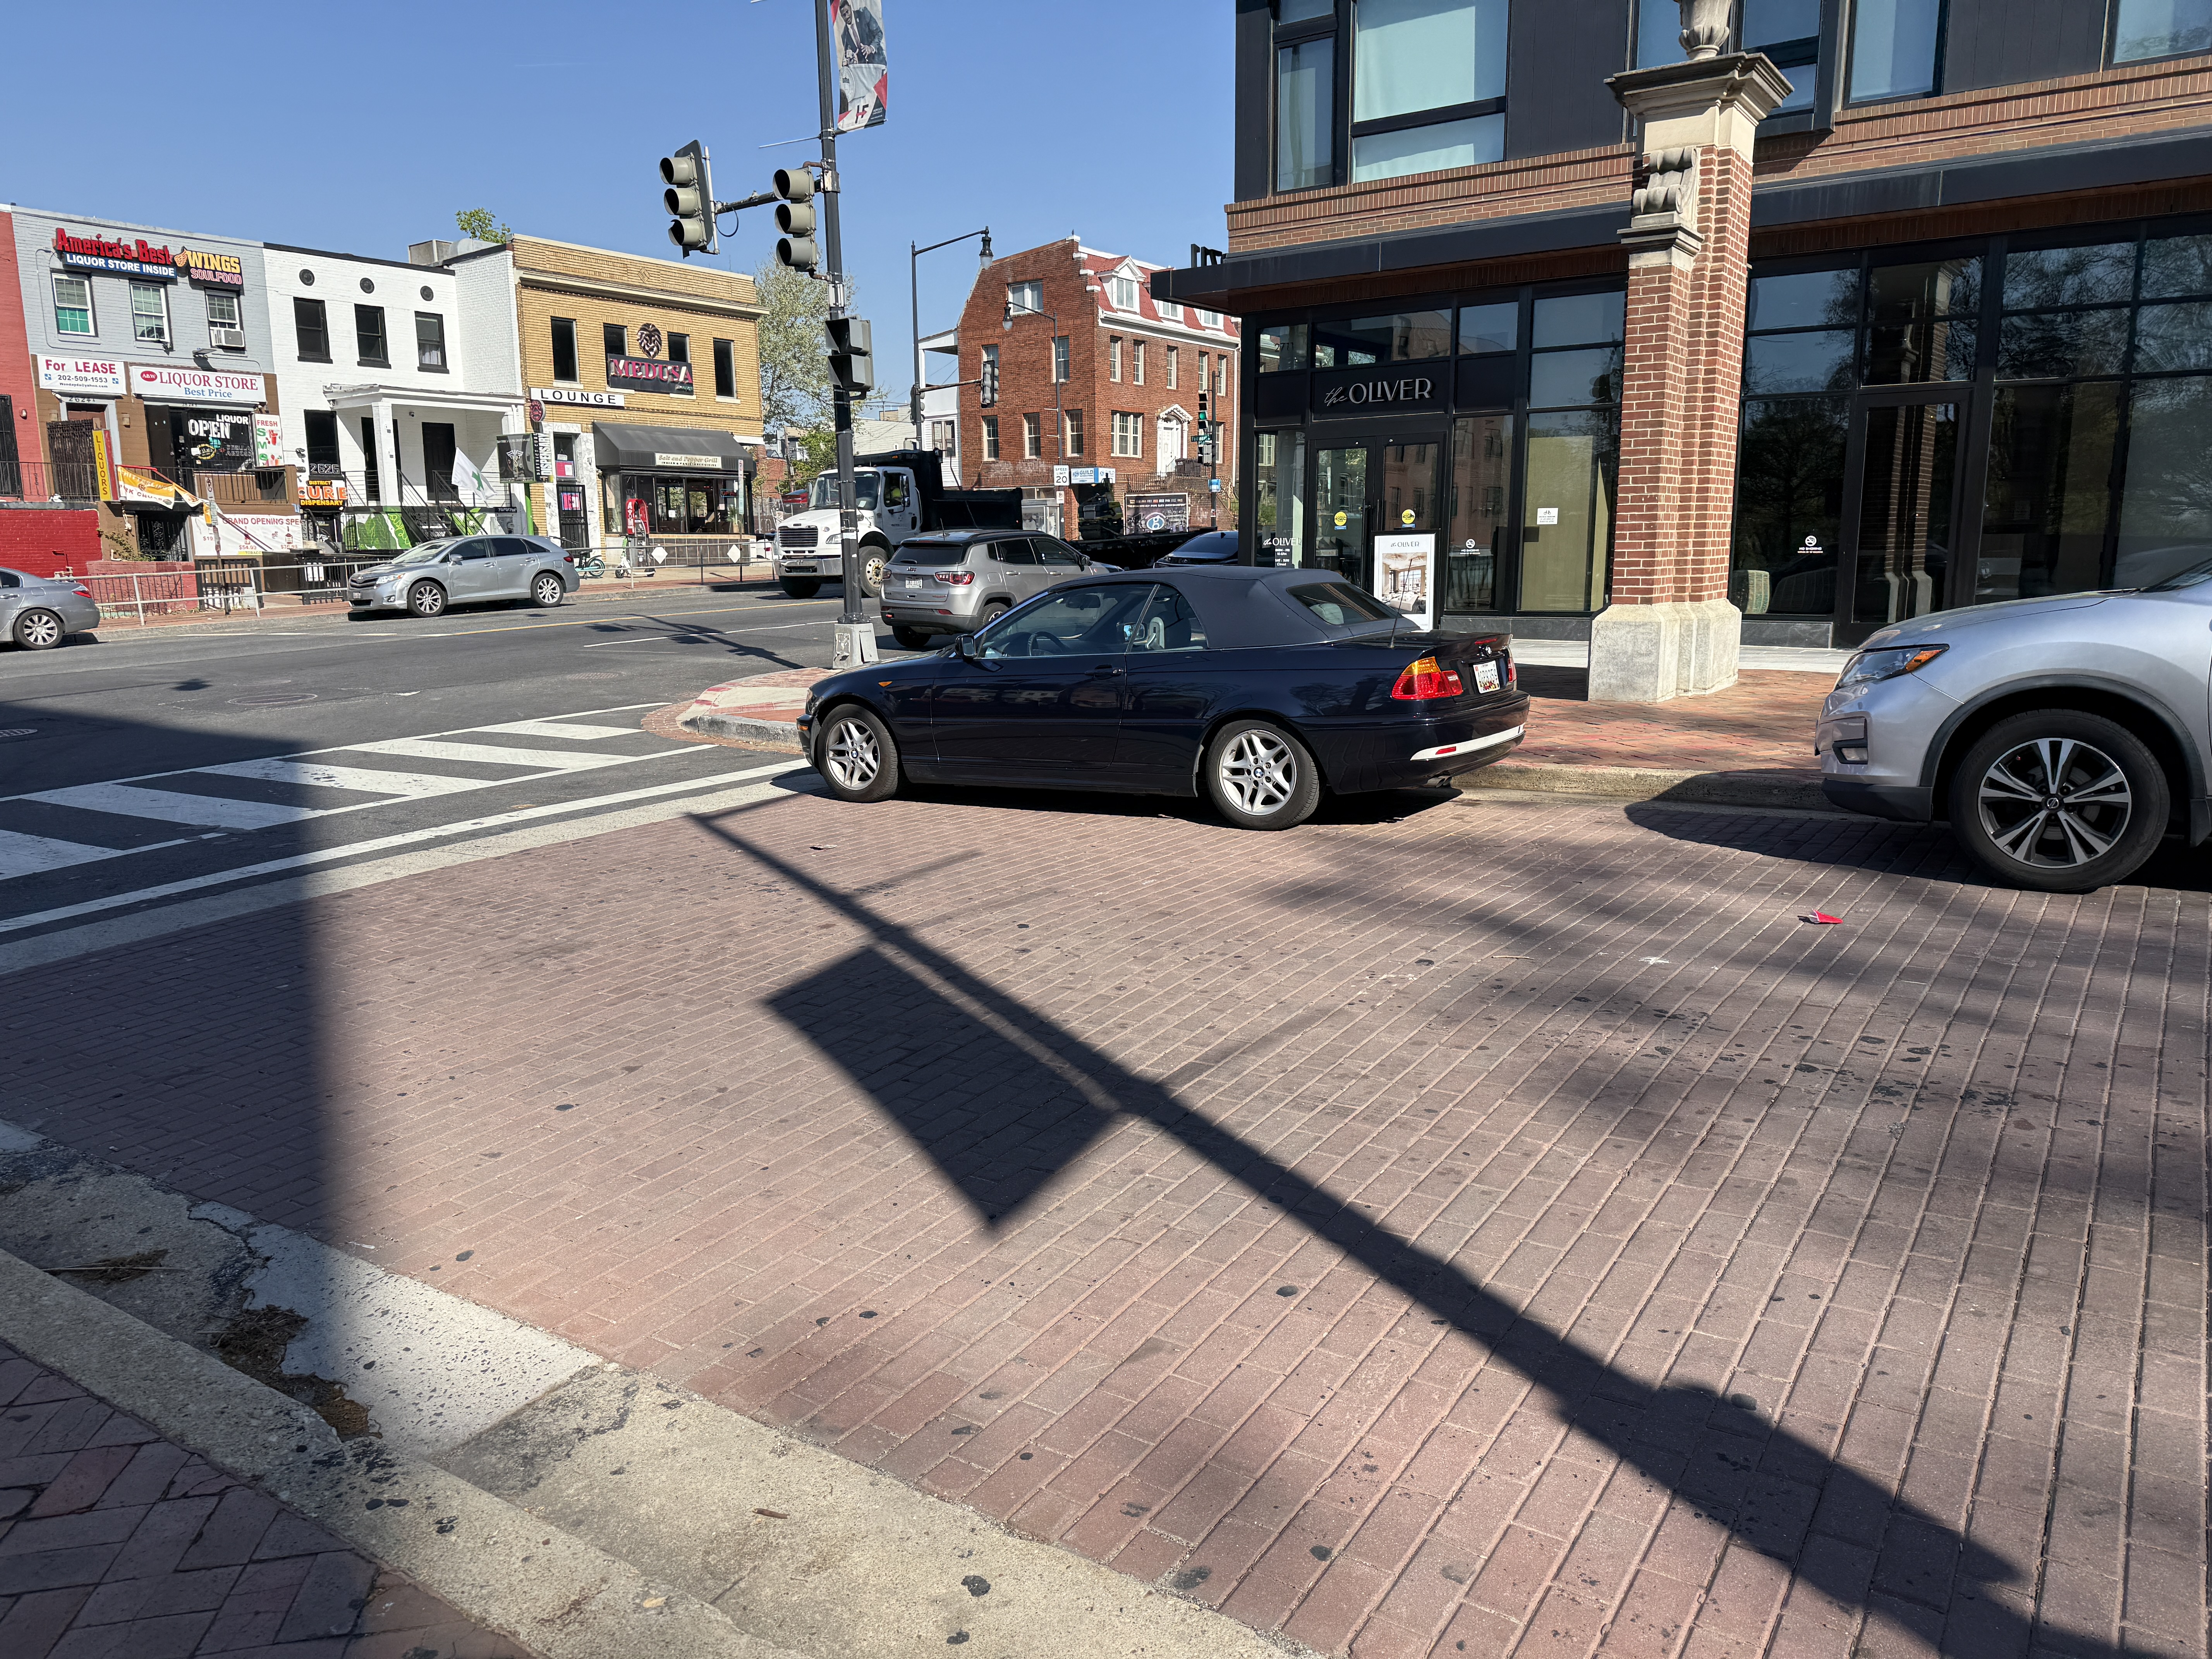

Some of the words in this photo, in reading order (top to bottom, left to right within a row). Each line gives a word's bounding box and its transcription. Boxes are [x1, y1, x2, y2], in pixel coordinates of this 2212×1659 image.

[56, 228, 132, 259] America's
[136, 239, 171, 264] Best
[67, 254, 106, 267] LIQUOR
[108, 260, 140, 271] STORE
[143, 264, 174, 276] INSIDE
[186, 251, 240, 273] WINGS
[191, 268, 242, 284] SOULFOOD
[45, 359, 65, 371] For
[75, 362, 117, 374] LEASE
[610, 359, 693, 383] MEDUSA
[158, 372, 212, 387] LIQUOR
[215, 376, 258, 390] STORE
[184, 388, 205, 396] Best
[208, 389, 232, 398] Price
[541, 390, 616, 404] LOUNGE
[1324, 387, 1348, 406] the
[1349, 378, 1432, 404] OLIVER
[216, 414, 249, 425] LIQUOR
[188, 419, 230, 439] OPEN
[538, 433, 553, 476] DISPENSARY
[96, 435, 108, 495] LIQUORS
[310, 464, 340, 474] 2626
[298, 486, 348, 500] CURE
[1273, 538, 1302, 546] OLIVER
